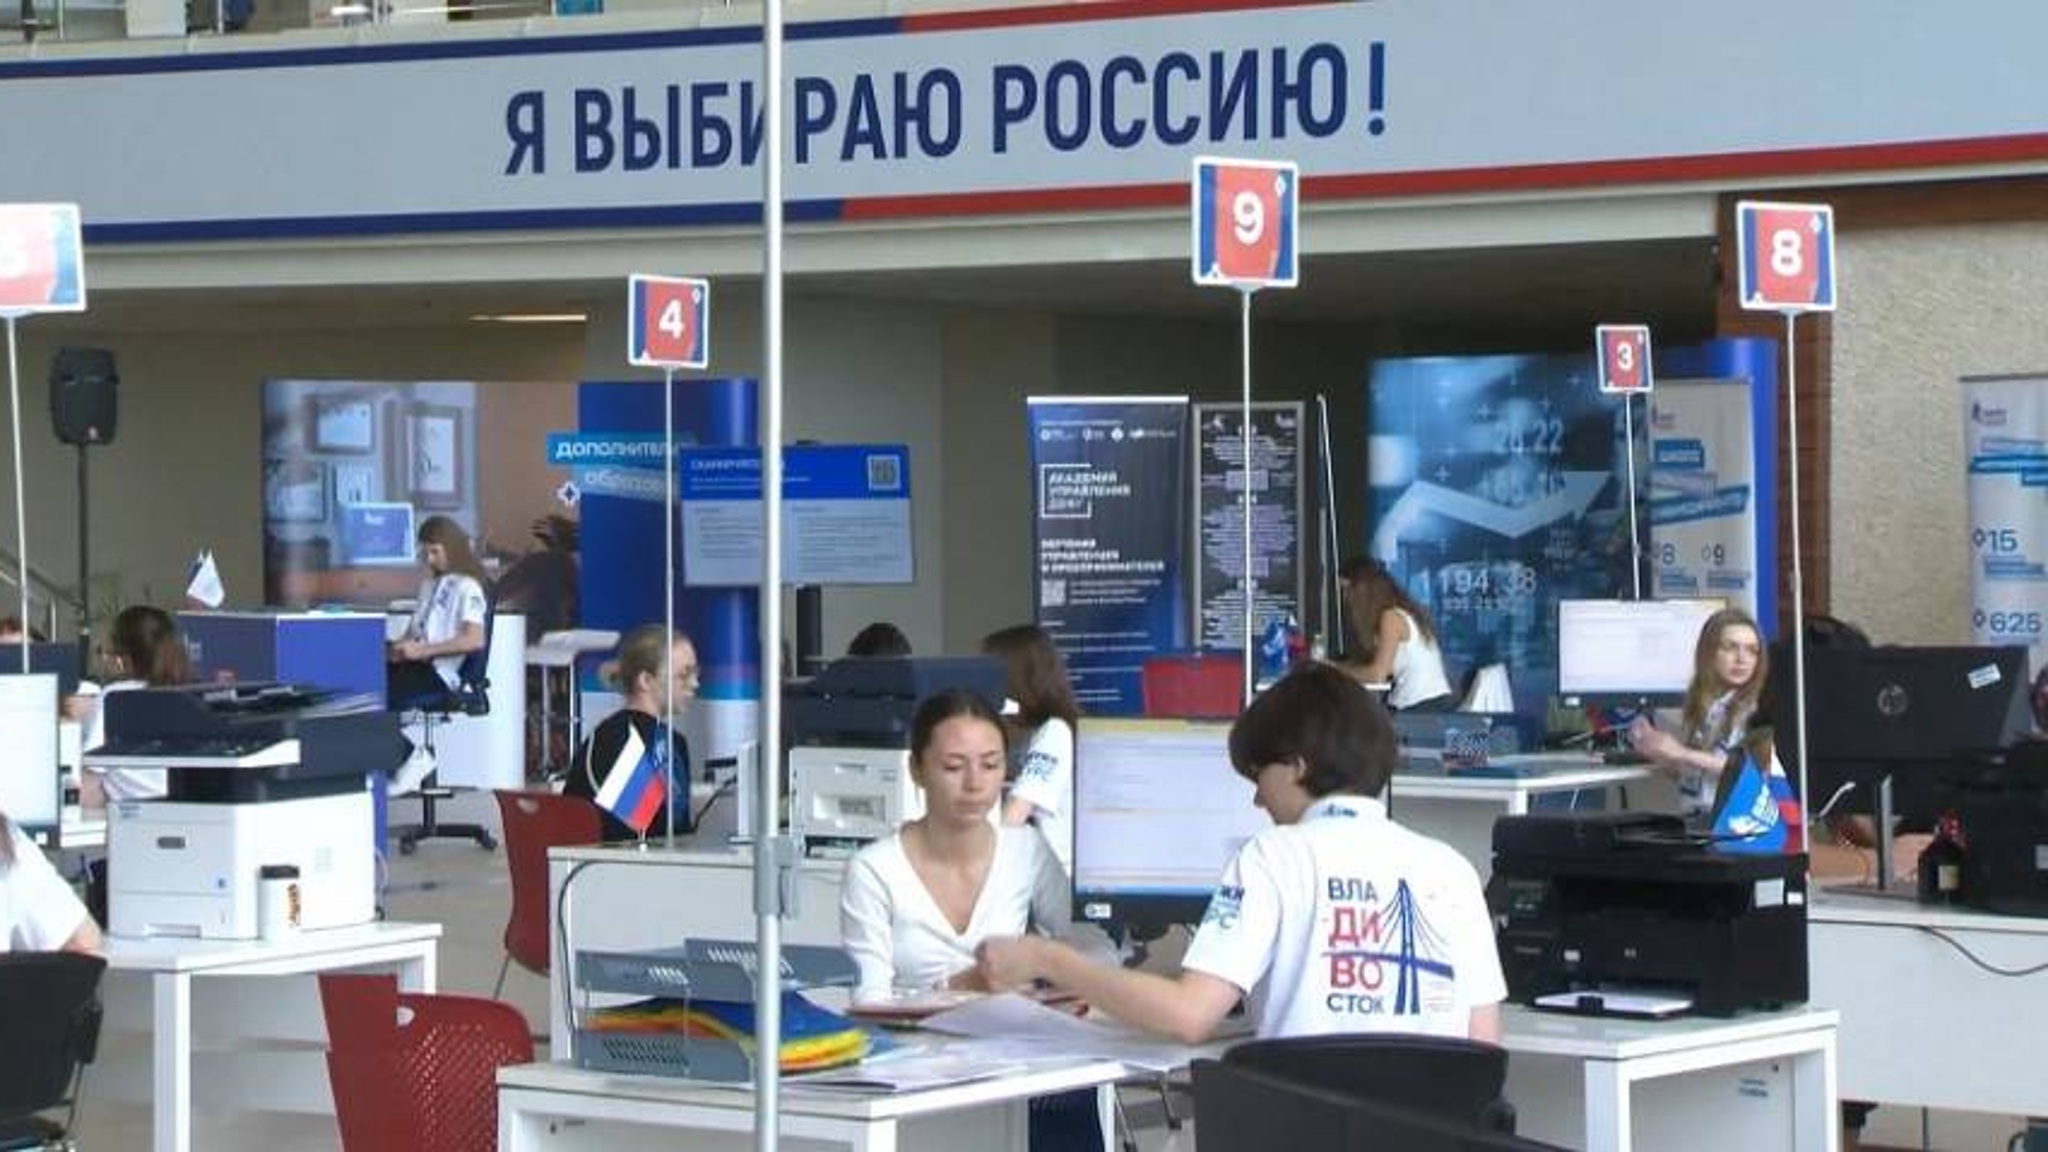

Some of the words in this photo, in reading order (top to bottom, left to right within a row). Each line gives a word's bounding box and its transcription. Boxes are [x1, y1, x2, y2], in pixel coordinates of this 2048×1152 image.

[504, 90, 546, 175] Я
[1232, 191, 1264, 244] 9
[1771, 229, 1802, 276] 8
[659, 299, 686, 340] 4
[1616, 341, 1633, 371] 3
[1662, 542, 1676, 565] 8
[1713, 543, 1724, 565] 9
[1988, 529, 2018, 551] 15
[1989, 612, 2042, 633] 625
[1327, 876, 1379, 902] ВЛА
[1328, 906, 1381, 948] ДИ
[1330, 955, 1384, 990] ВО
[1326, 992, 1385, 1015] СТОК
